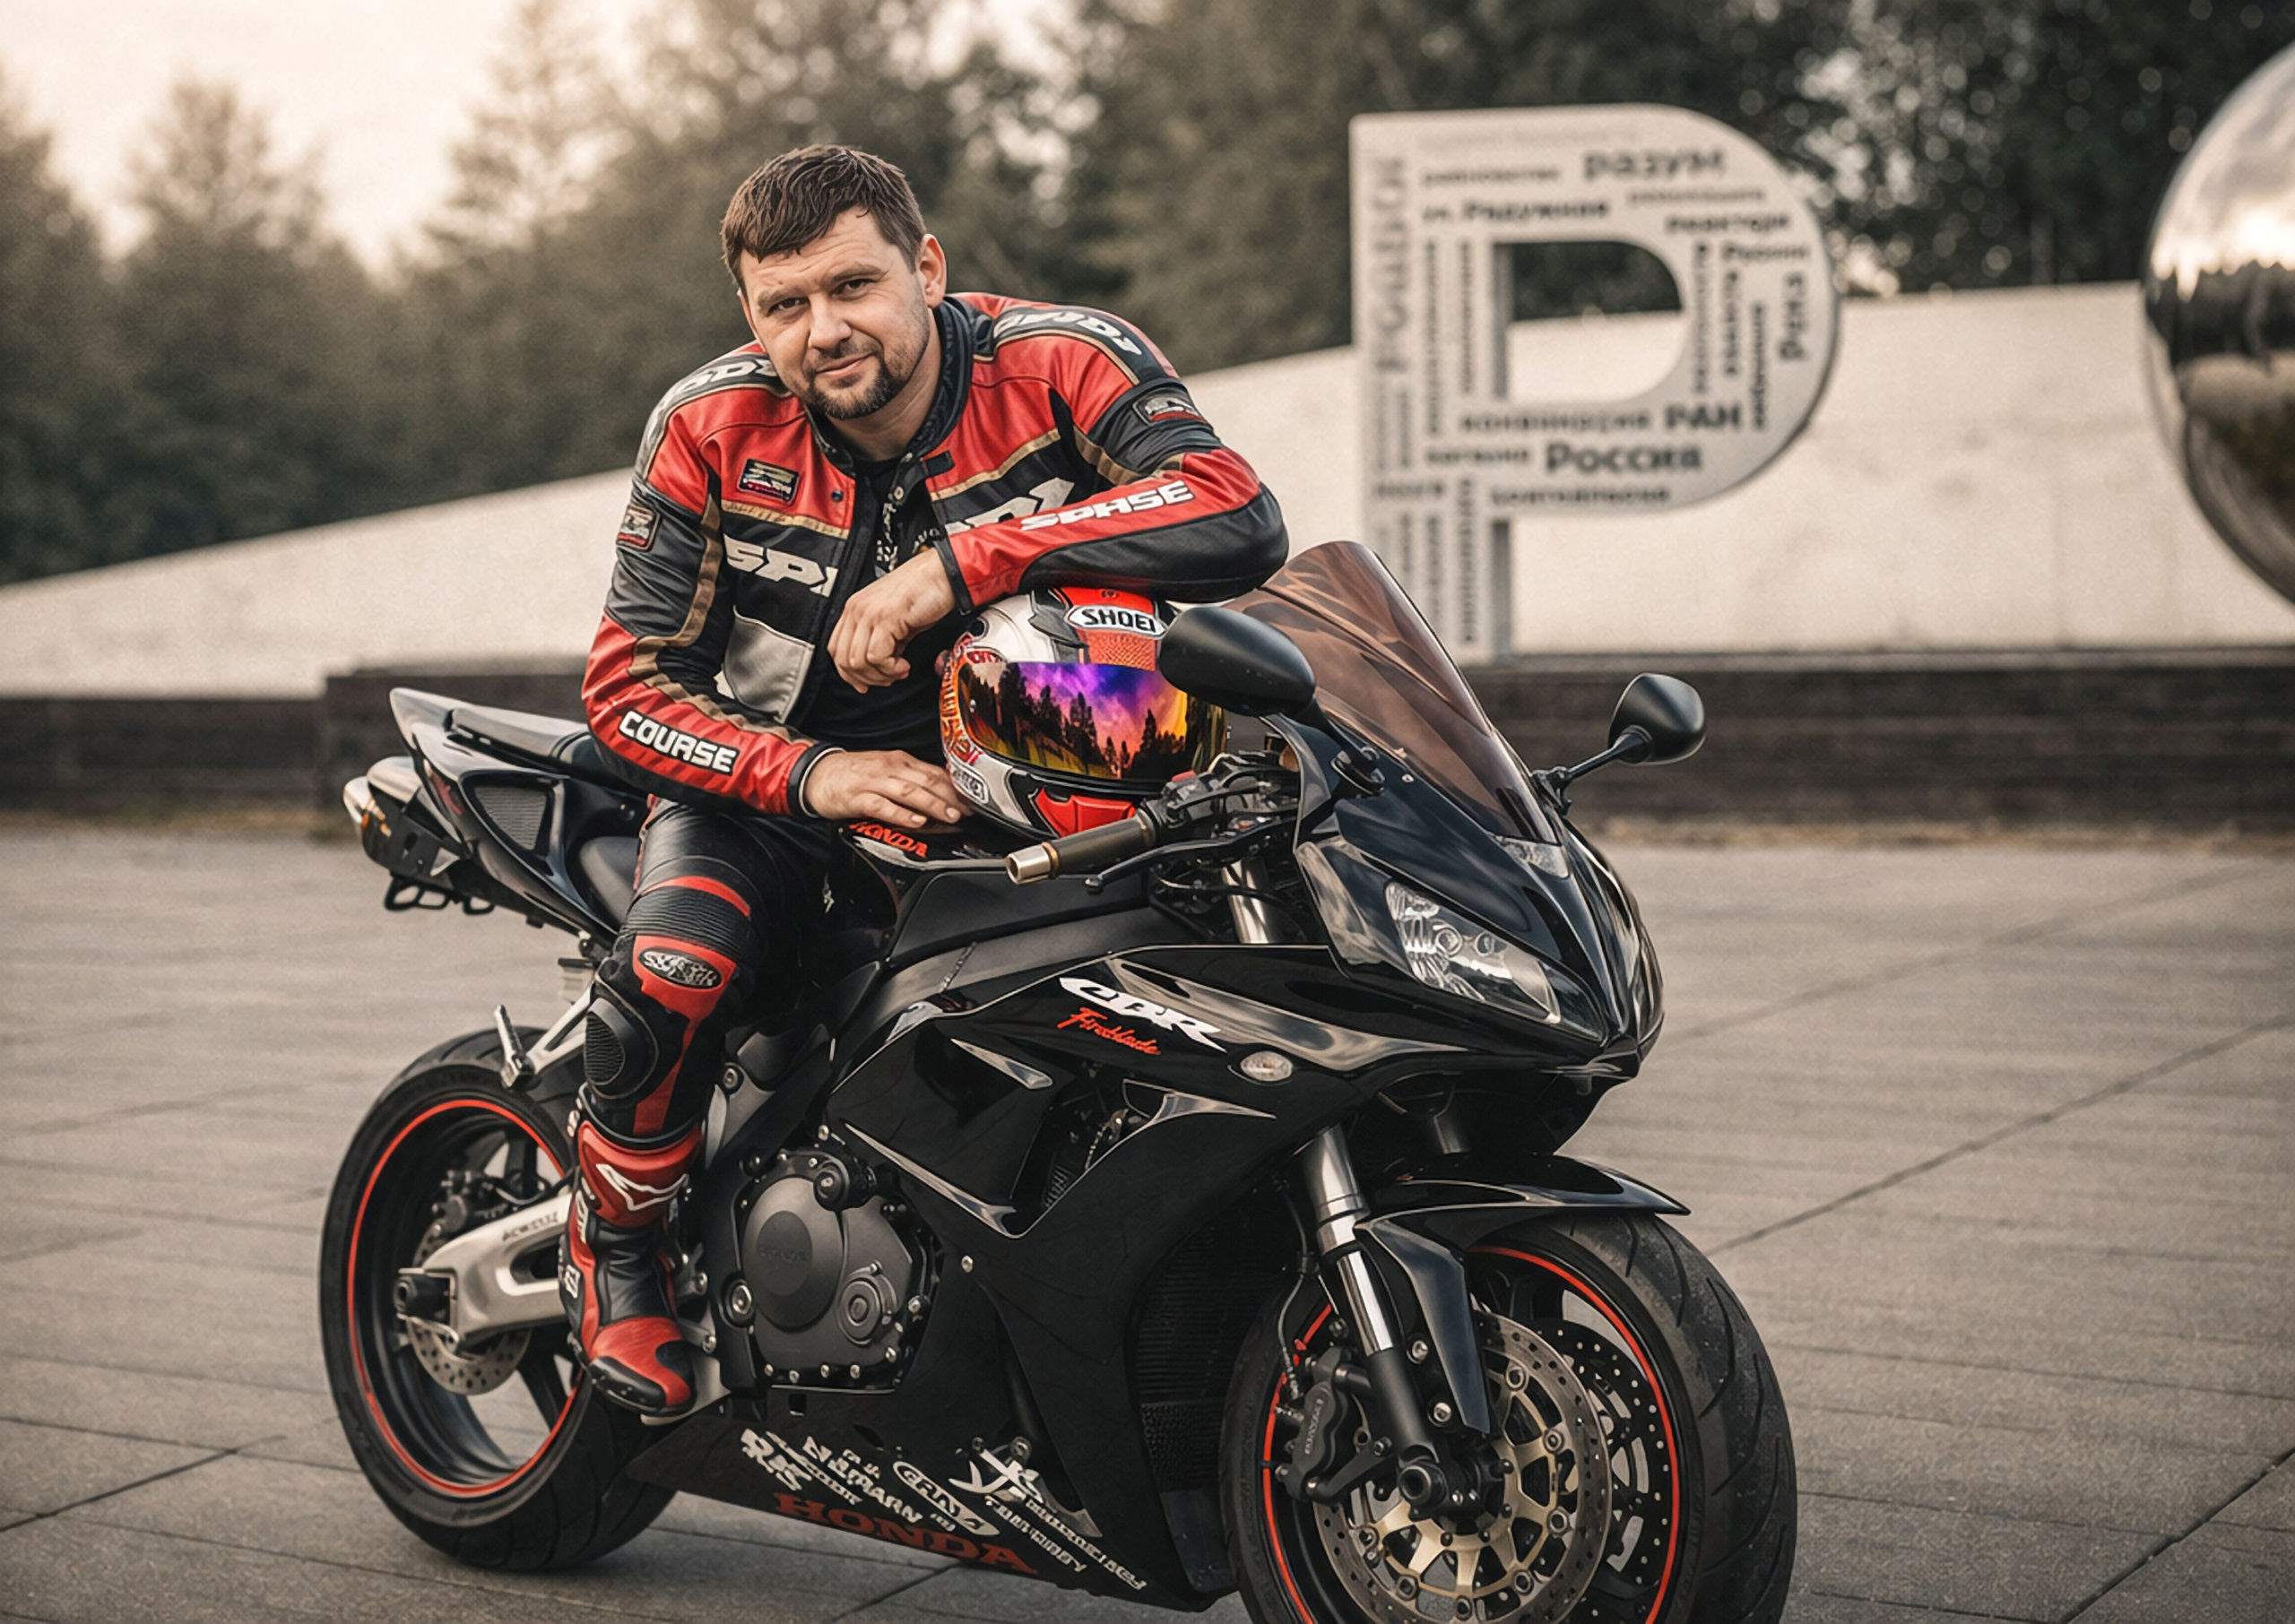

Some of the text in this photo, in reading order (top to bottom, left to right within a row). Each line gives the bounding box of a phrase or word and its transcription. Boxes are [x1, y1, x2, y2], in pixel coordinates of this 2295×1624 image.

[1544, 444, 1703, 475] Россия
[1081, 608, 1156, 634] SHOEI
[619, 710, 737, 773] COURSE
[1059, 977, 1228, 1054] CBR
[772, 1491, 1039, 1576] HONDA
